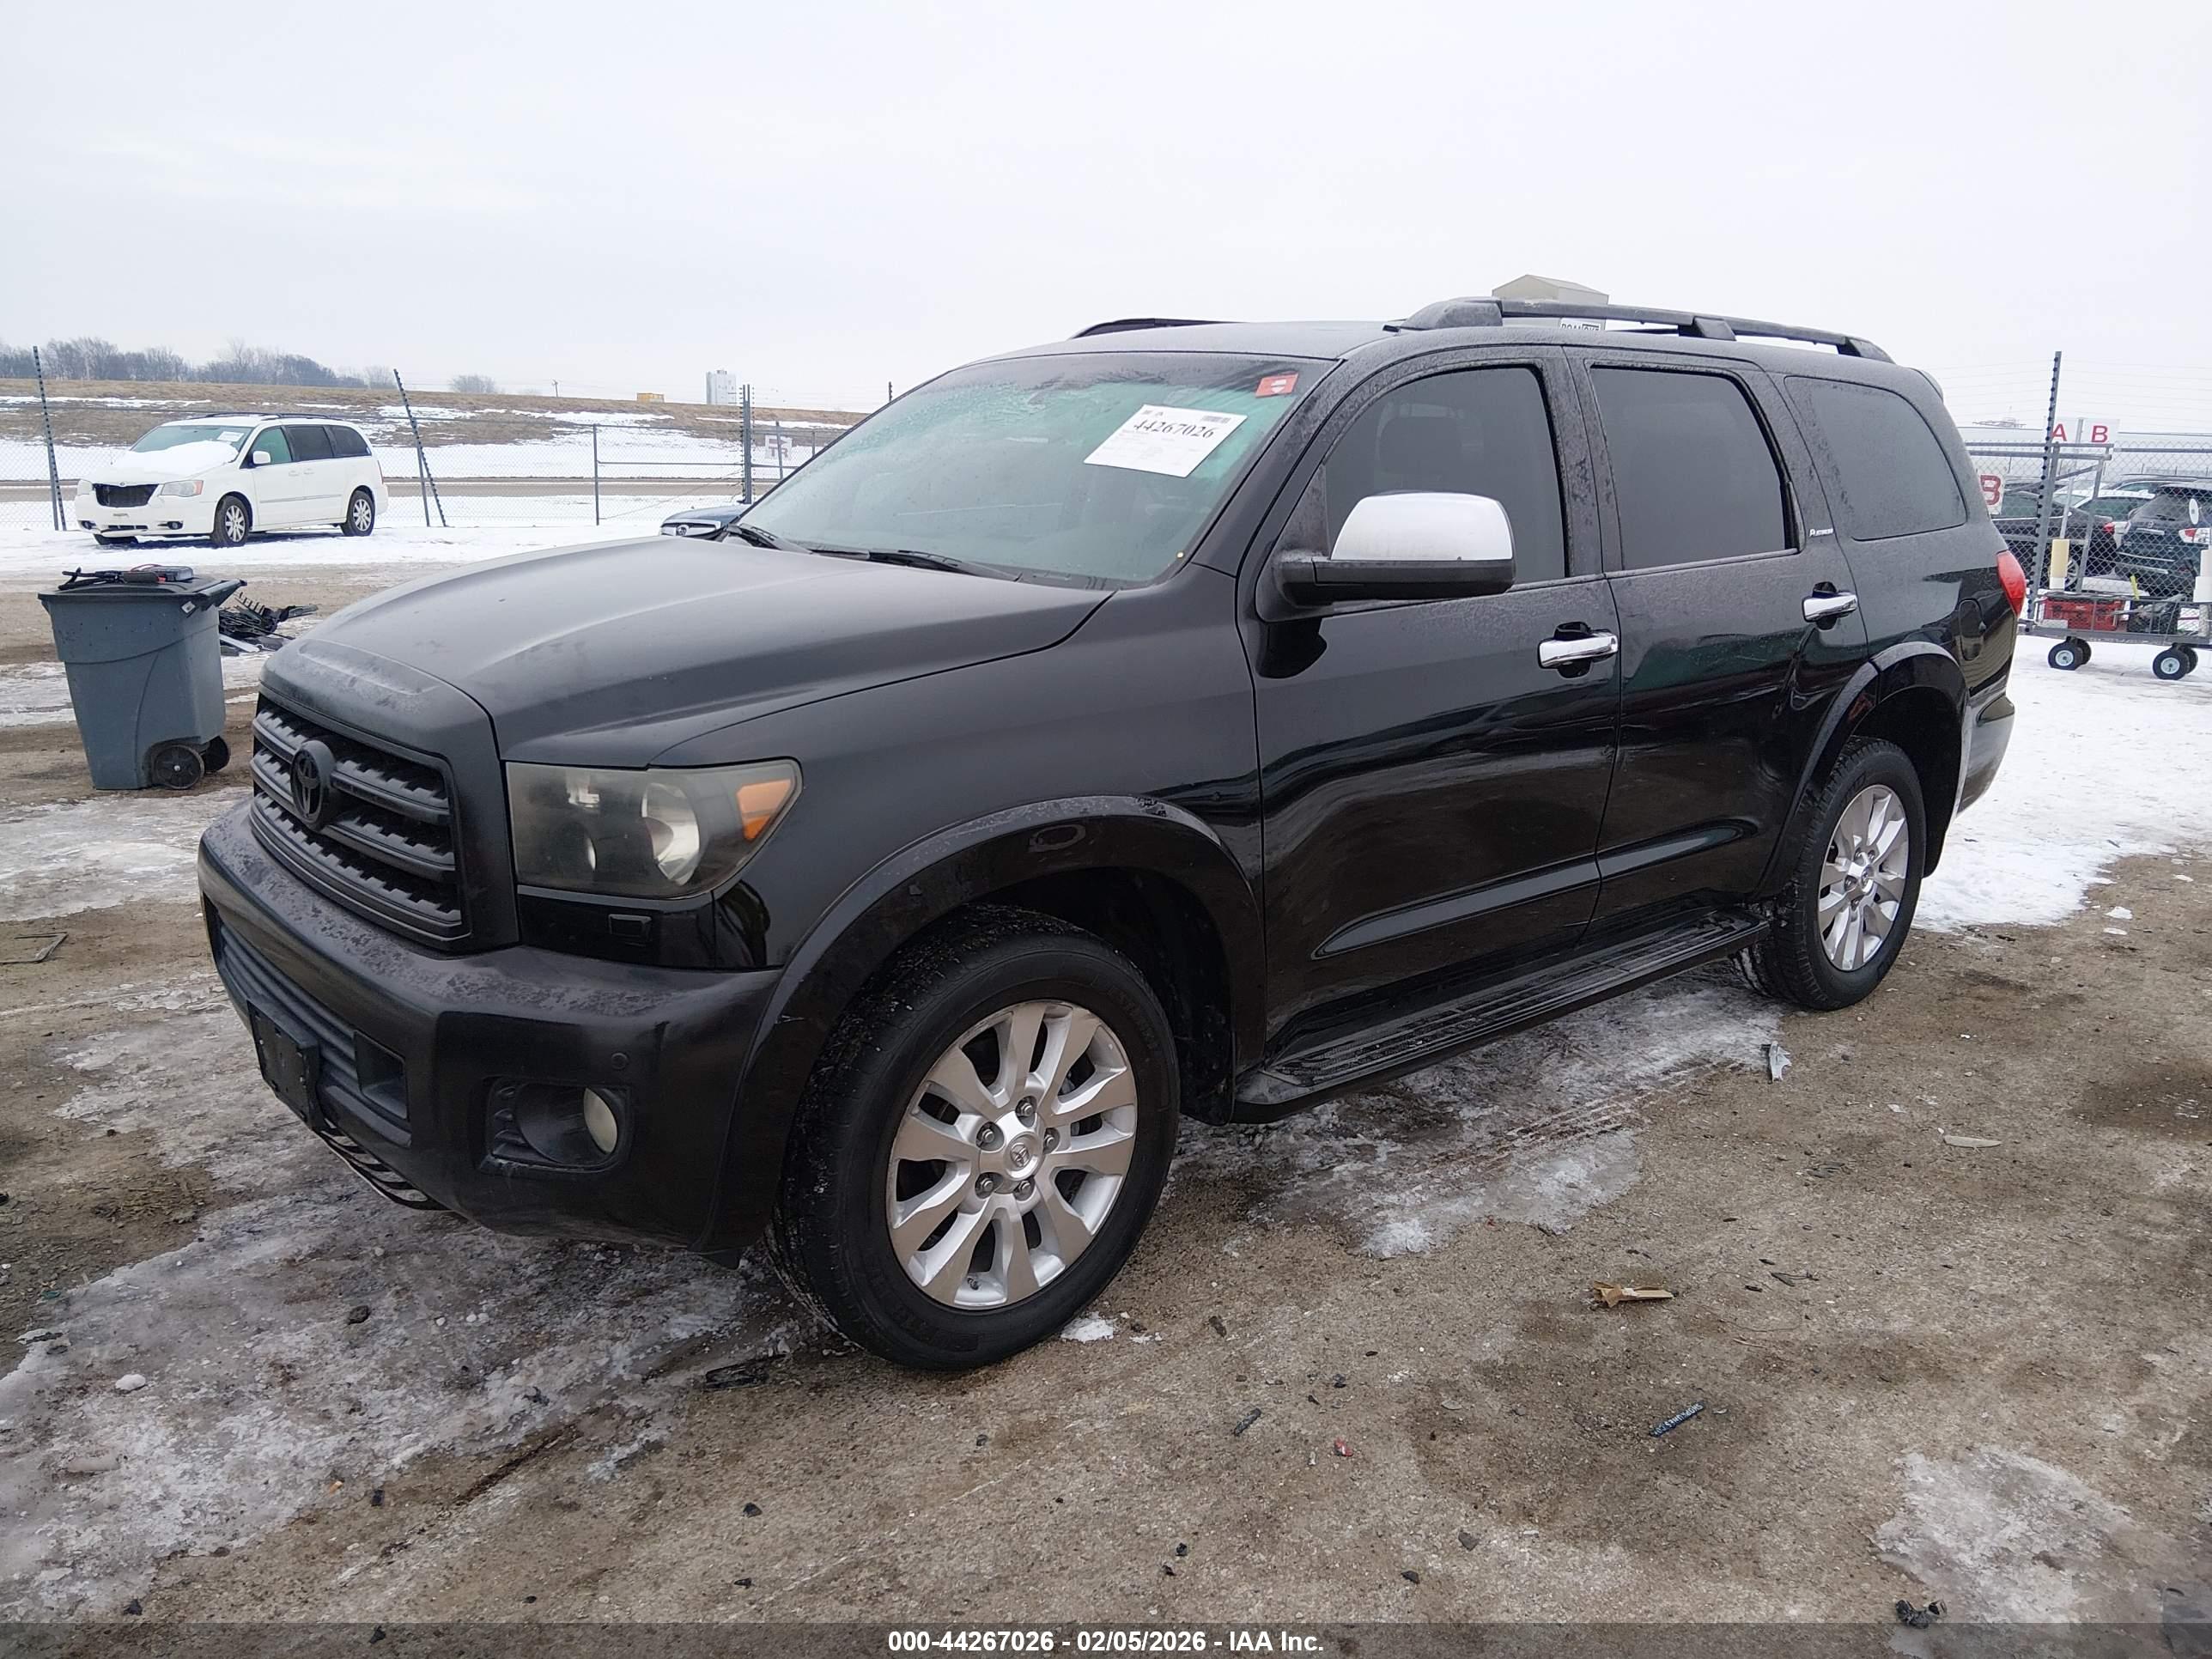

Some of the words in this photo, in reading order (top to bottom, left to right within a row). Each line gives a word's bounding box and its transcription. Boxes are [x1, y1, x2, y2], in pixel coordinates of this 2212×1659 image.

[1133, 420, 1217, 439] 44267026
[2051, 422, 2067, 442] A
[2091, 425, 2109, 443] B
